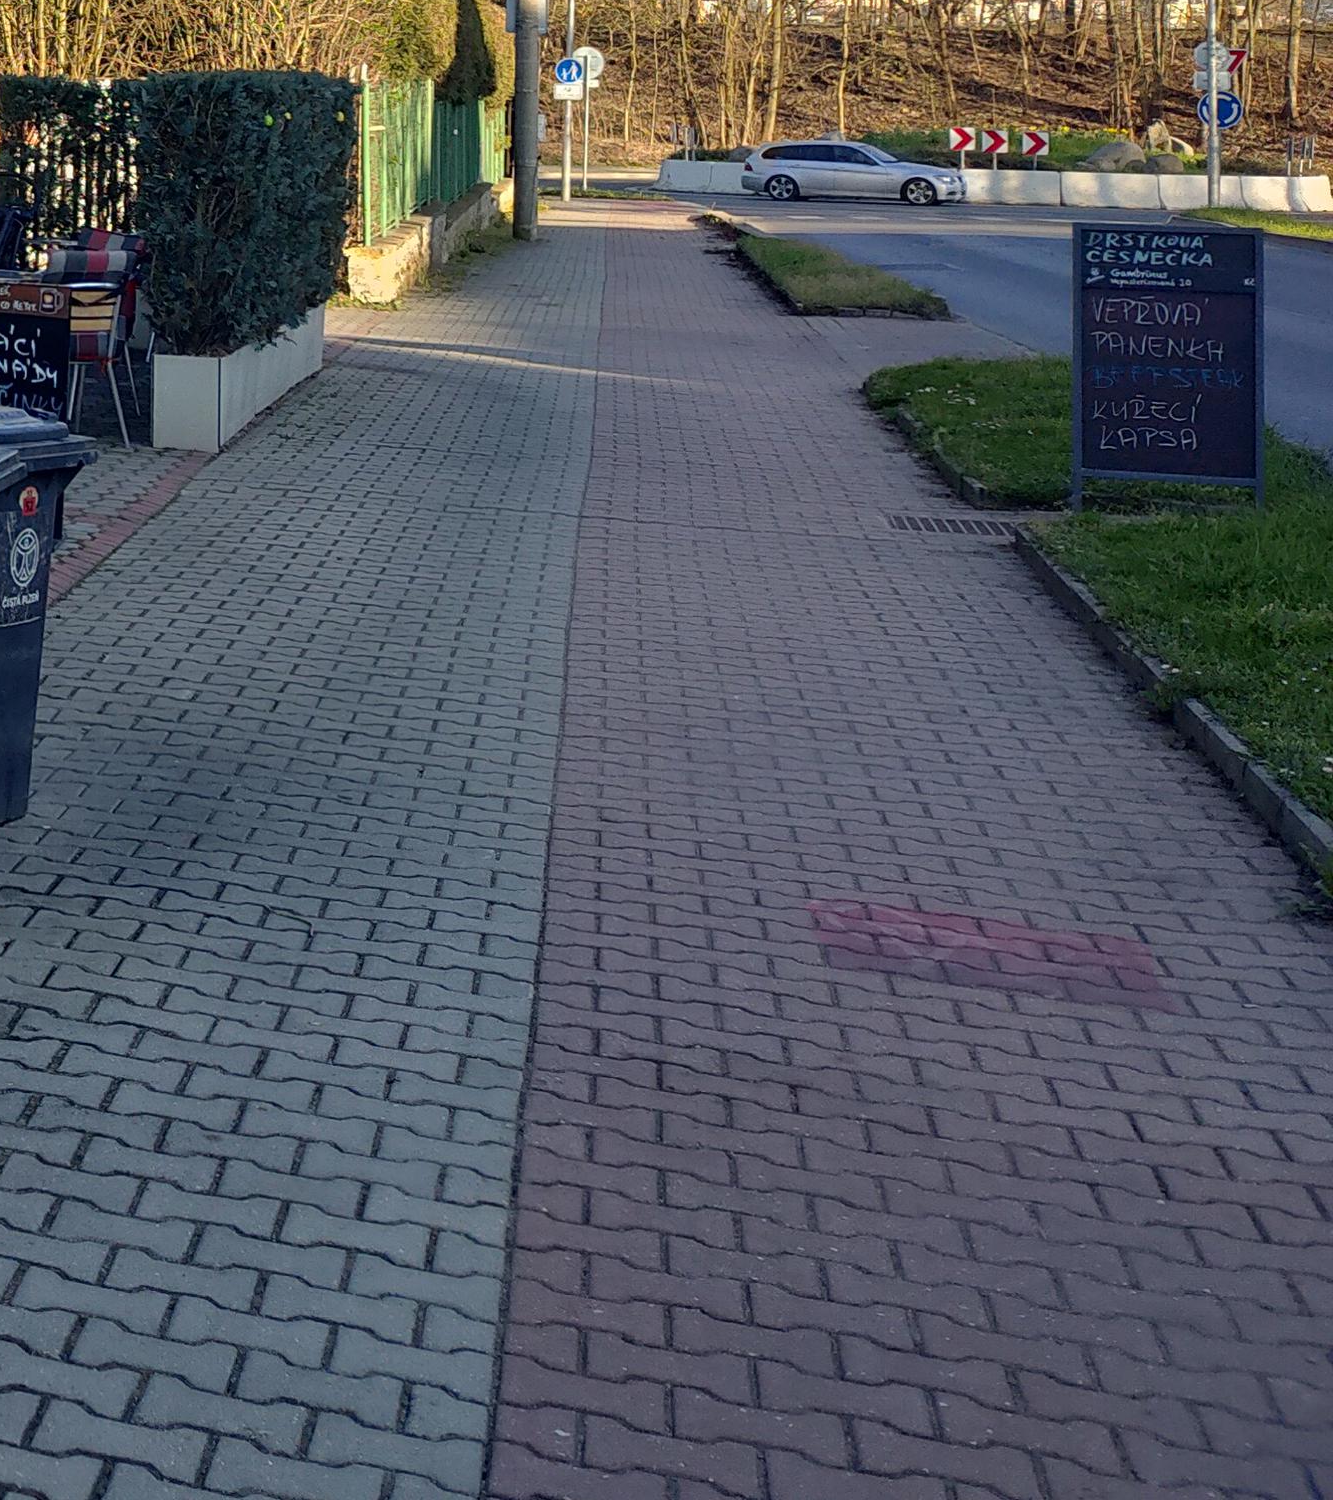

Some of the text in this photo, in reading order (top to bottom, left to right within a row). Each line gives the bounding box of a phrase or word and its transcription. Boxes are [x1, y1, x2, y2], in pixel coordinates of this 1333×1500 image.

[1110, 267, 1169, 279] Gambrinus
[1092, 295, 1209, 327] VEPŘOVÁ
[1090, 331, 1224, 362] PANENKA
[1092, 393, 1202, 423] KUŘECÍ
[1100, 425, 1197, 450] KAPSA
